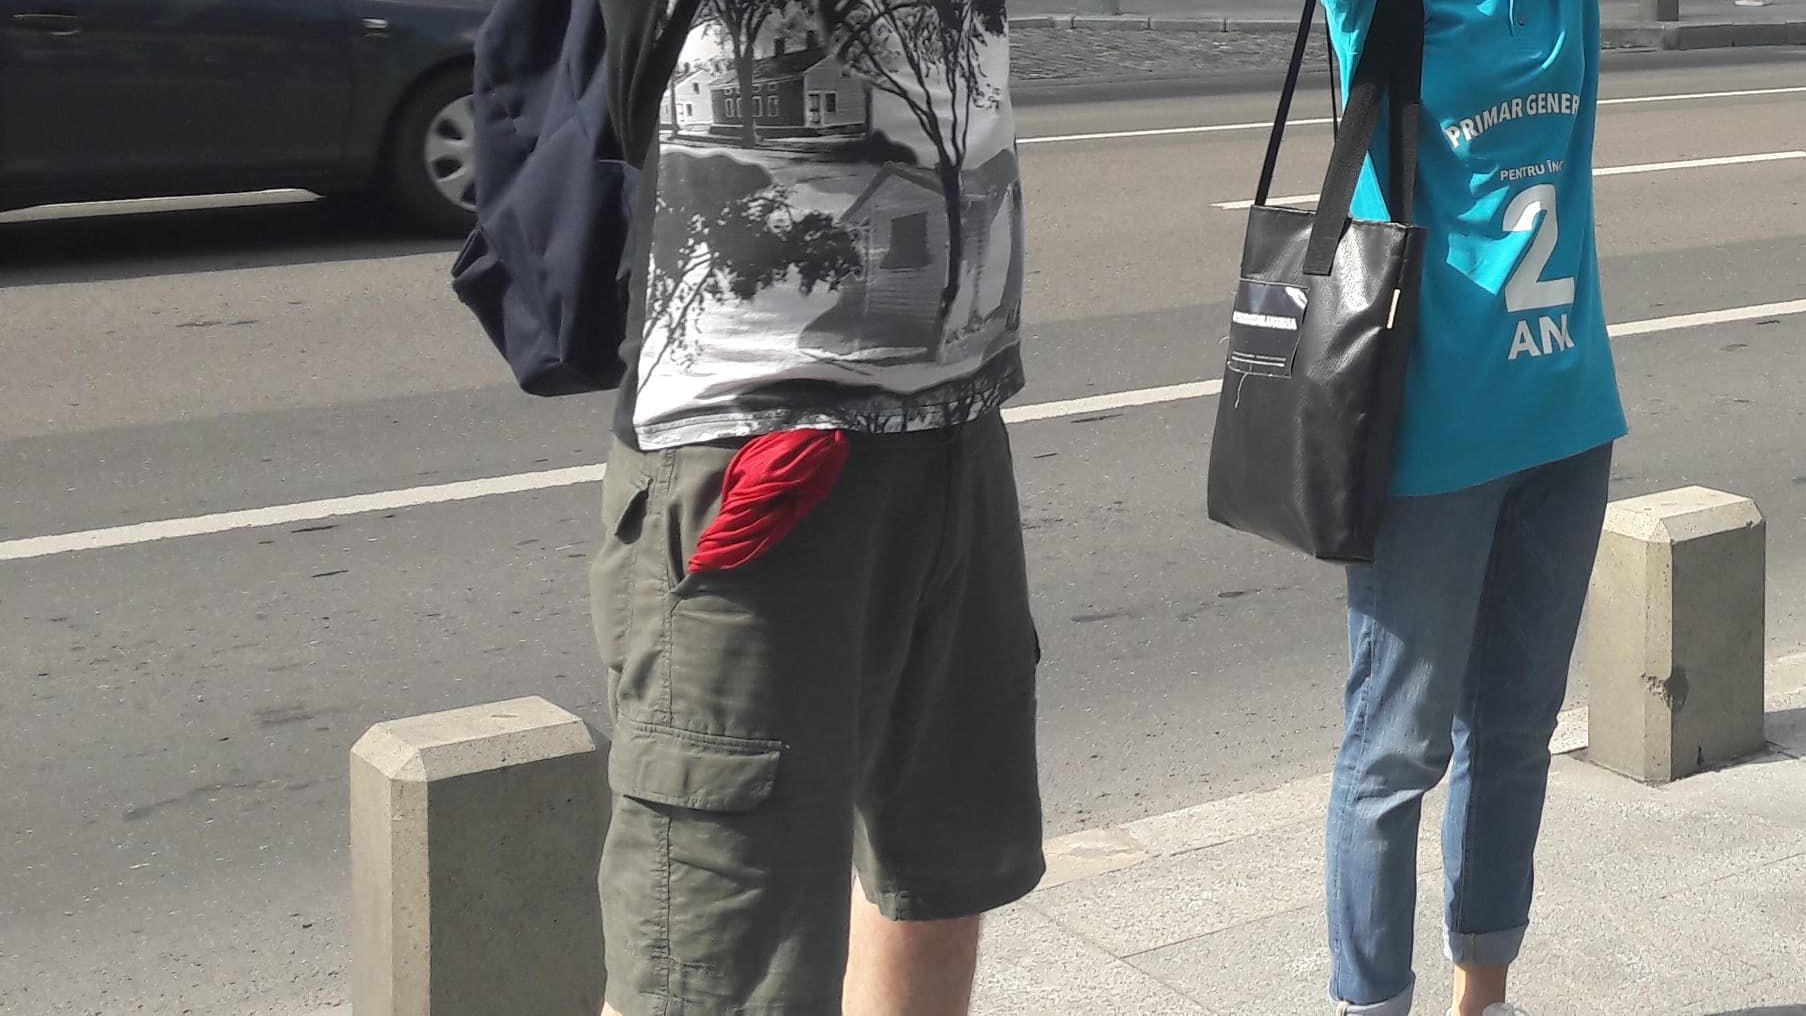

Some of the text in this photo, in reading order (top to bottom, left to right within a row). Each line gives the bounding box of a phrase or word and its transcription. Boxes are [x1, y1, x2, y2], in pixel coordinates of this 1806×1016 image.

[1443, 97, 1524, 149] PRIMAR
[1499, 165, 1546, 182] PENTRU
[1501, 183, 1576, 313] 2
